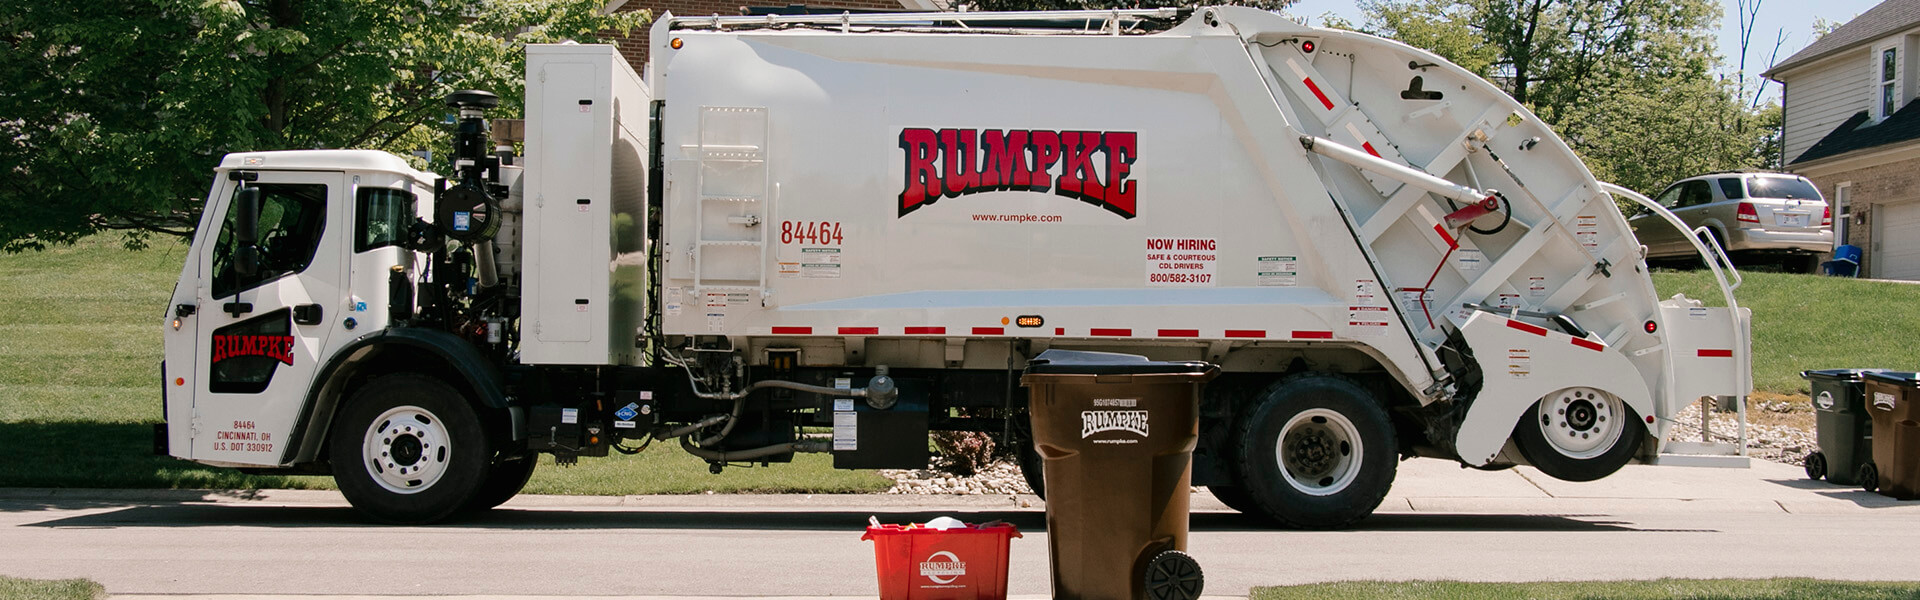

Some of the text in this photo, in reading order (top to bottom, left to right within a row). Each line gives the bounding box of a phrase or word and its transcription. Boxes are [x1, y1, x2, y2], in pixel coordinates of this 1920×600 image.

[898, 128, 1137, 219] RUMPKE
[972, 213, 1062, 223] www.rumpke.com
[781, 221, 843, 245] 84464
[1147, 239, 1216, 251] NOW HIRING
[1150, 273, 1212, 283] 800/582-3107
[213, 335, 295, 366] RUMPKE
[234, 420, 255, 429] 84464
[1081, 410, 1149, 439] RUMPKE
[217, 431, 271, 441] CINCINNATI, OH
[214, 442, 273, 452] U.S. DOT 330912
[920, 562, 966, 570] RUMPKE
